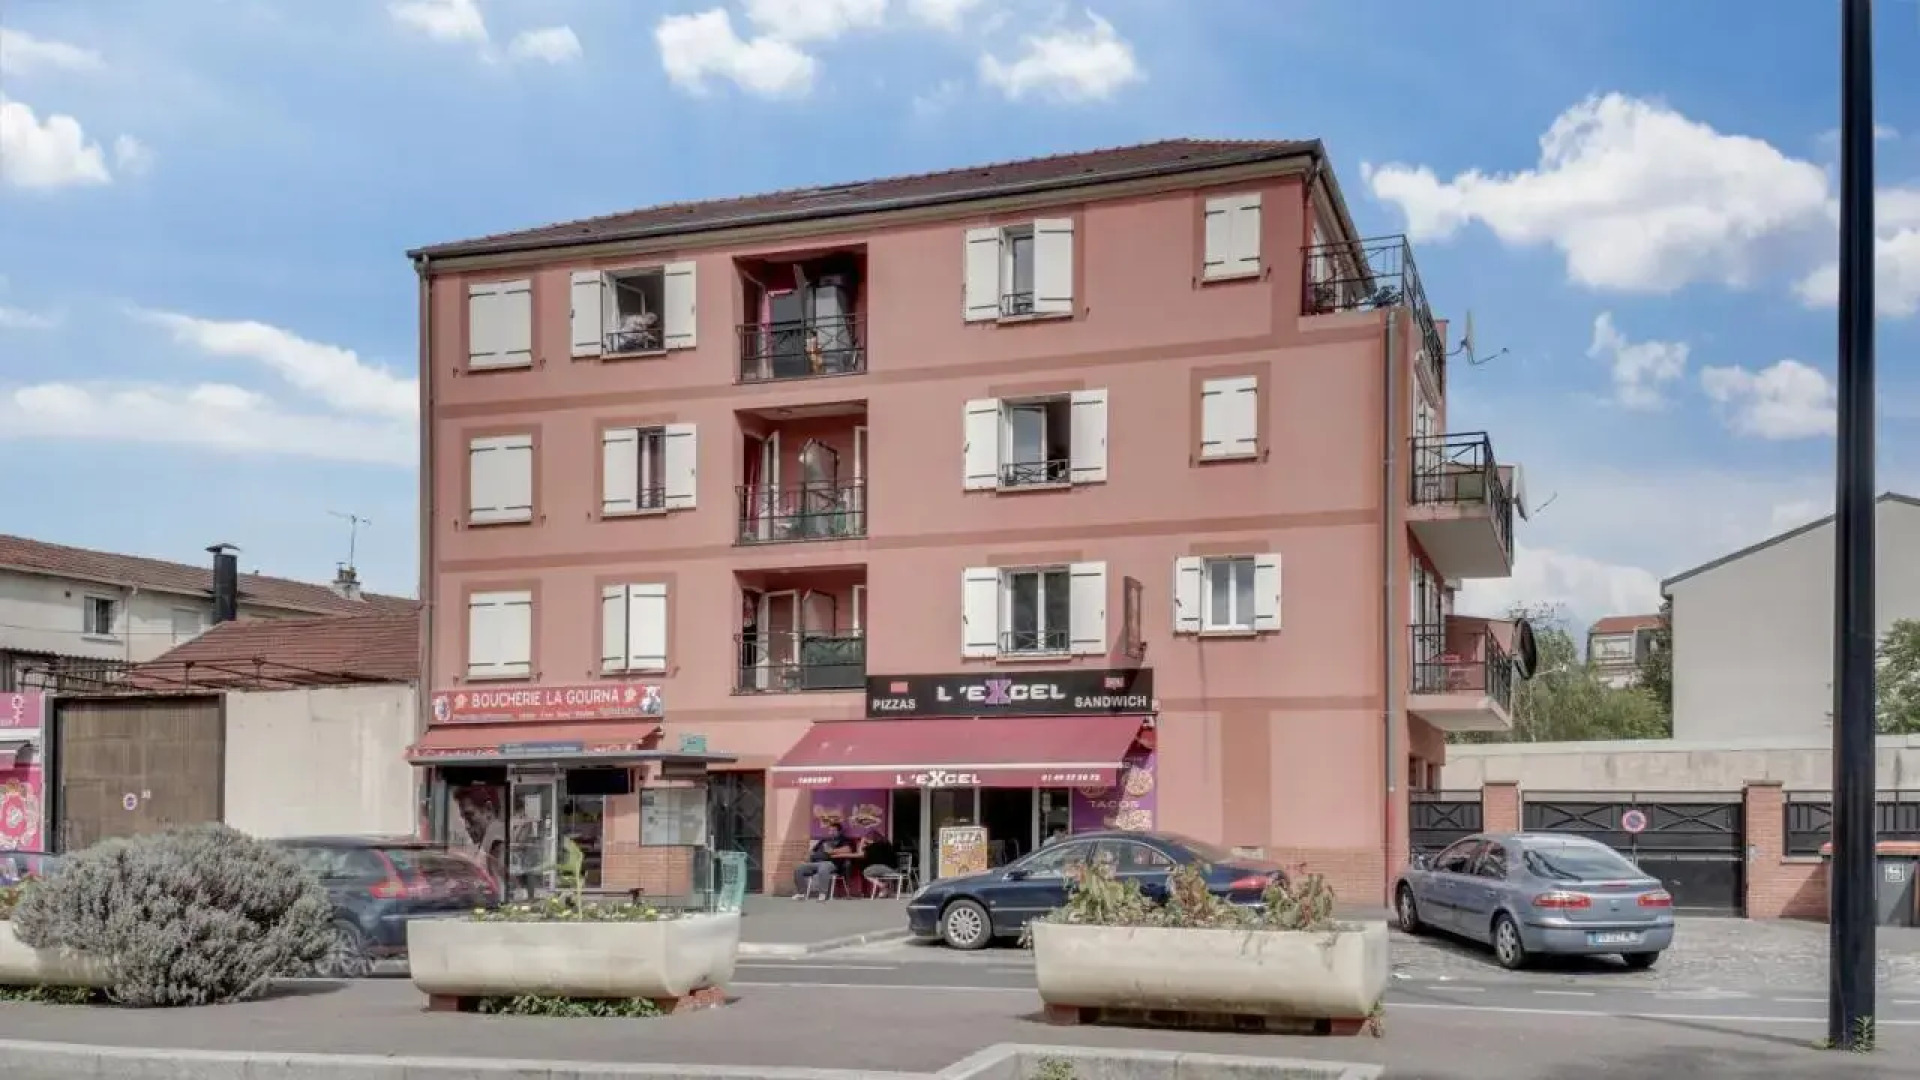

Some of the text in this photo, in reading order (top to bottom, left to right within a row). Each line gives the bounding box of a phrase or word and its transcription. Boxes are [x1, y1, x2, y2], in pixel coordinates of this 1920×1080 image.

[471, 688, 619, 709] BOUCHERIE LA GOURNA
[872, 698, 916, 711] PIZZAS
[1074, 694, 1147, 709] SANDWICH
[1090, 800, 1141, 809] TACOS
